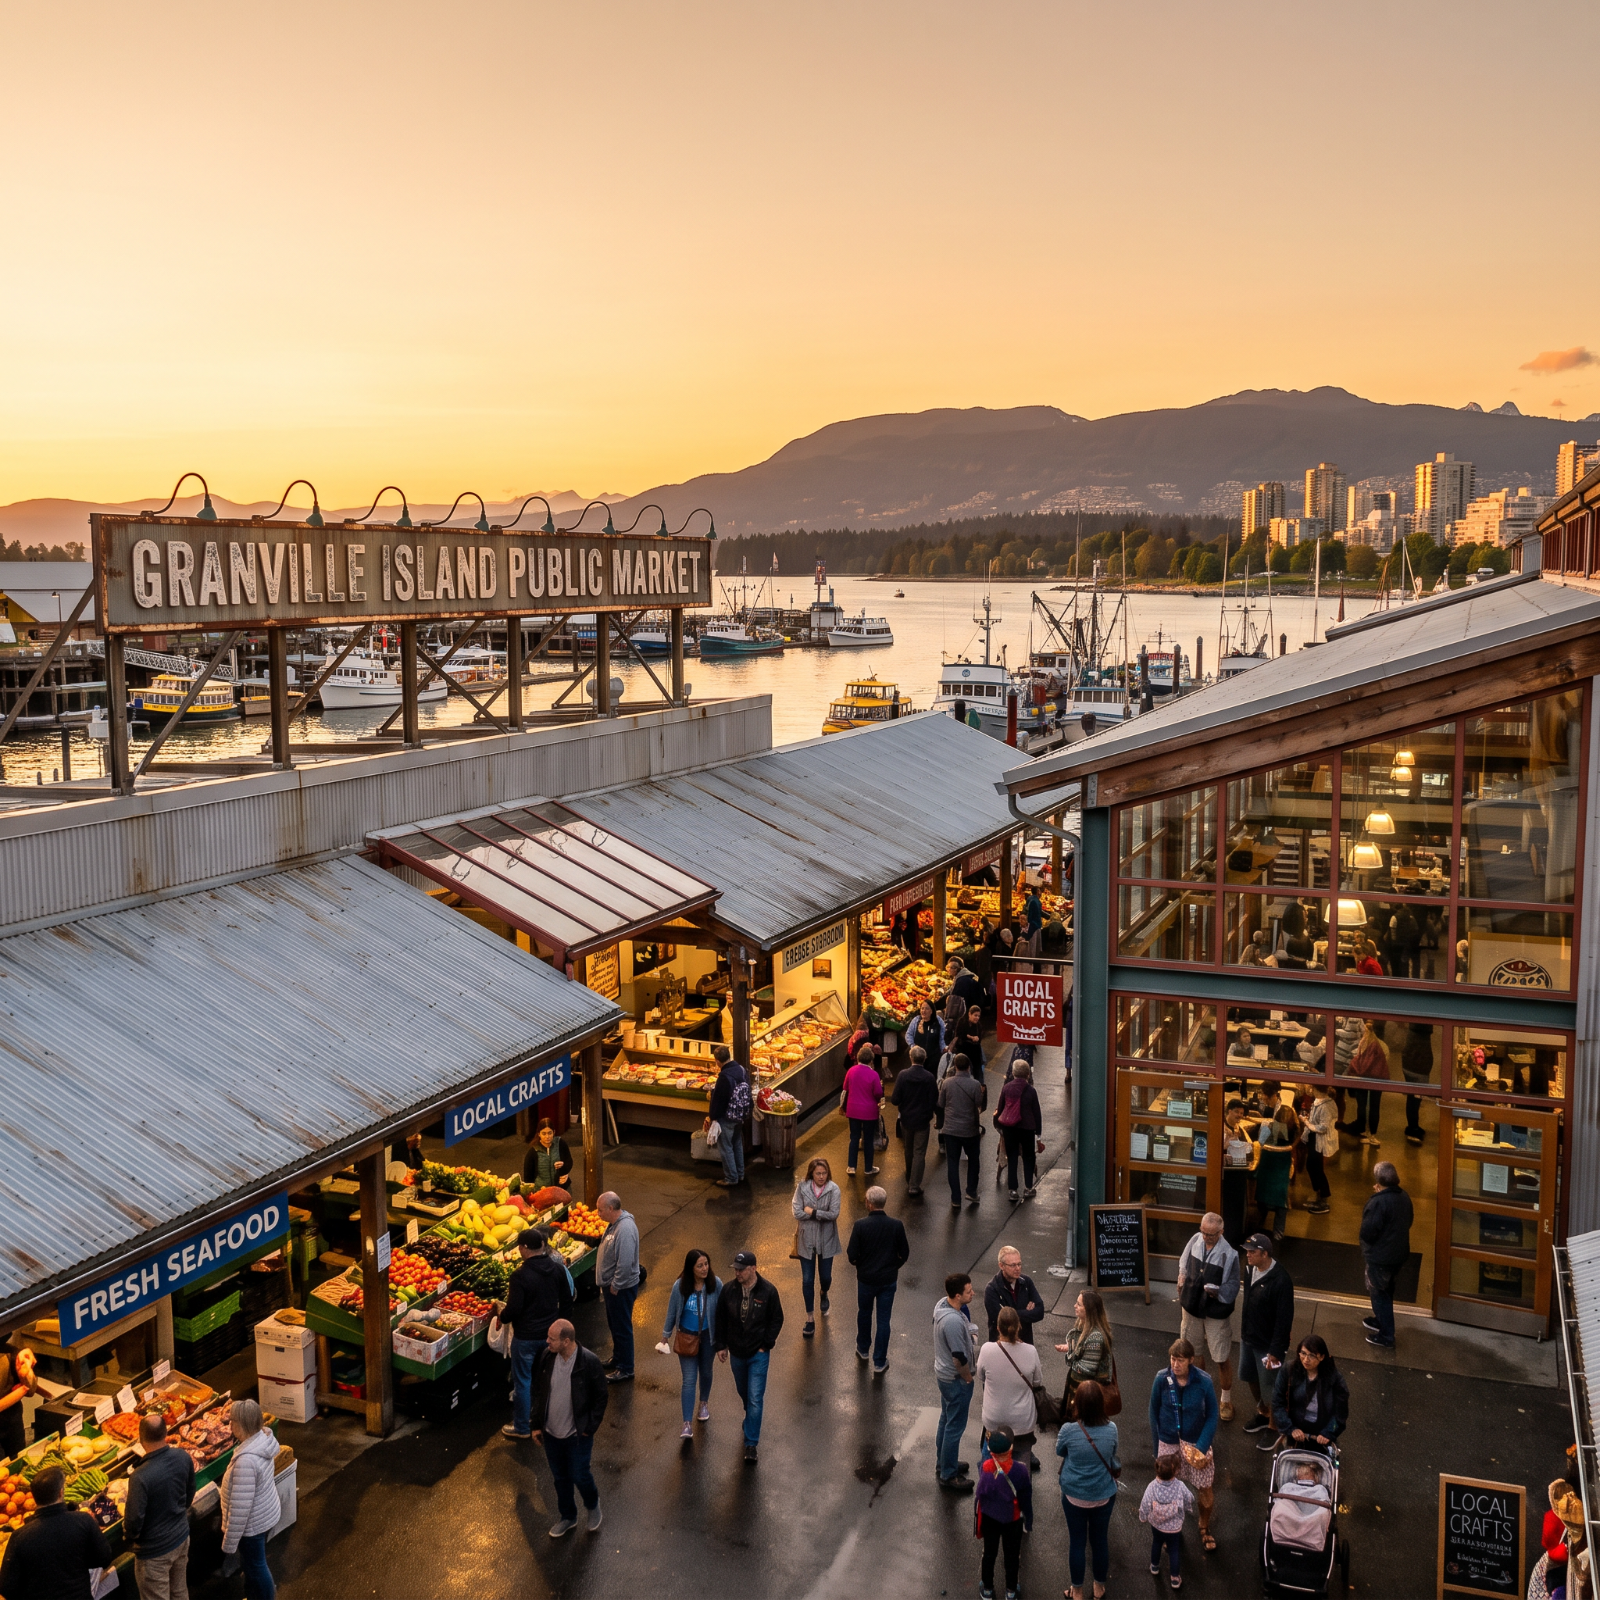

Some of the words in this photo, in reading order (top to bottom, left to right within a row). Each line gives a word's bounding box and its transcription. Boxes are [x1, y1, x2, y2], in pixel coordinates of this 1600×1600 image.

[132, 539, 367, 609] GRANVILLE
[382, 544, 497, 602] ISLAND
[509, 547, 603, 599] PUBLIC
[612, 549, 701, 595] MARKET
[1005, 979, 1053, 1000] LOCAL
[1003, 999, 1055, 1019] CRAFTS
[454, 1094, 506, 1136] LOCAL
[508, 1062, 564, 1107] CRAFTS
[74, 1263, 159, 1330] FRESH
[167, 1205, 280, 1282] SEAFOOD
[1451, 1490, 1514, 1520] LOCAL
[1450, 1513, 1513, 1542] CRAFTS
